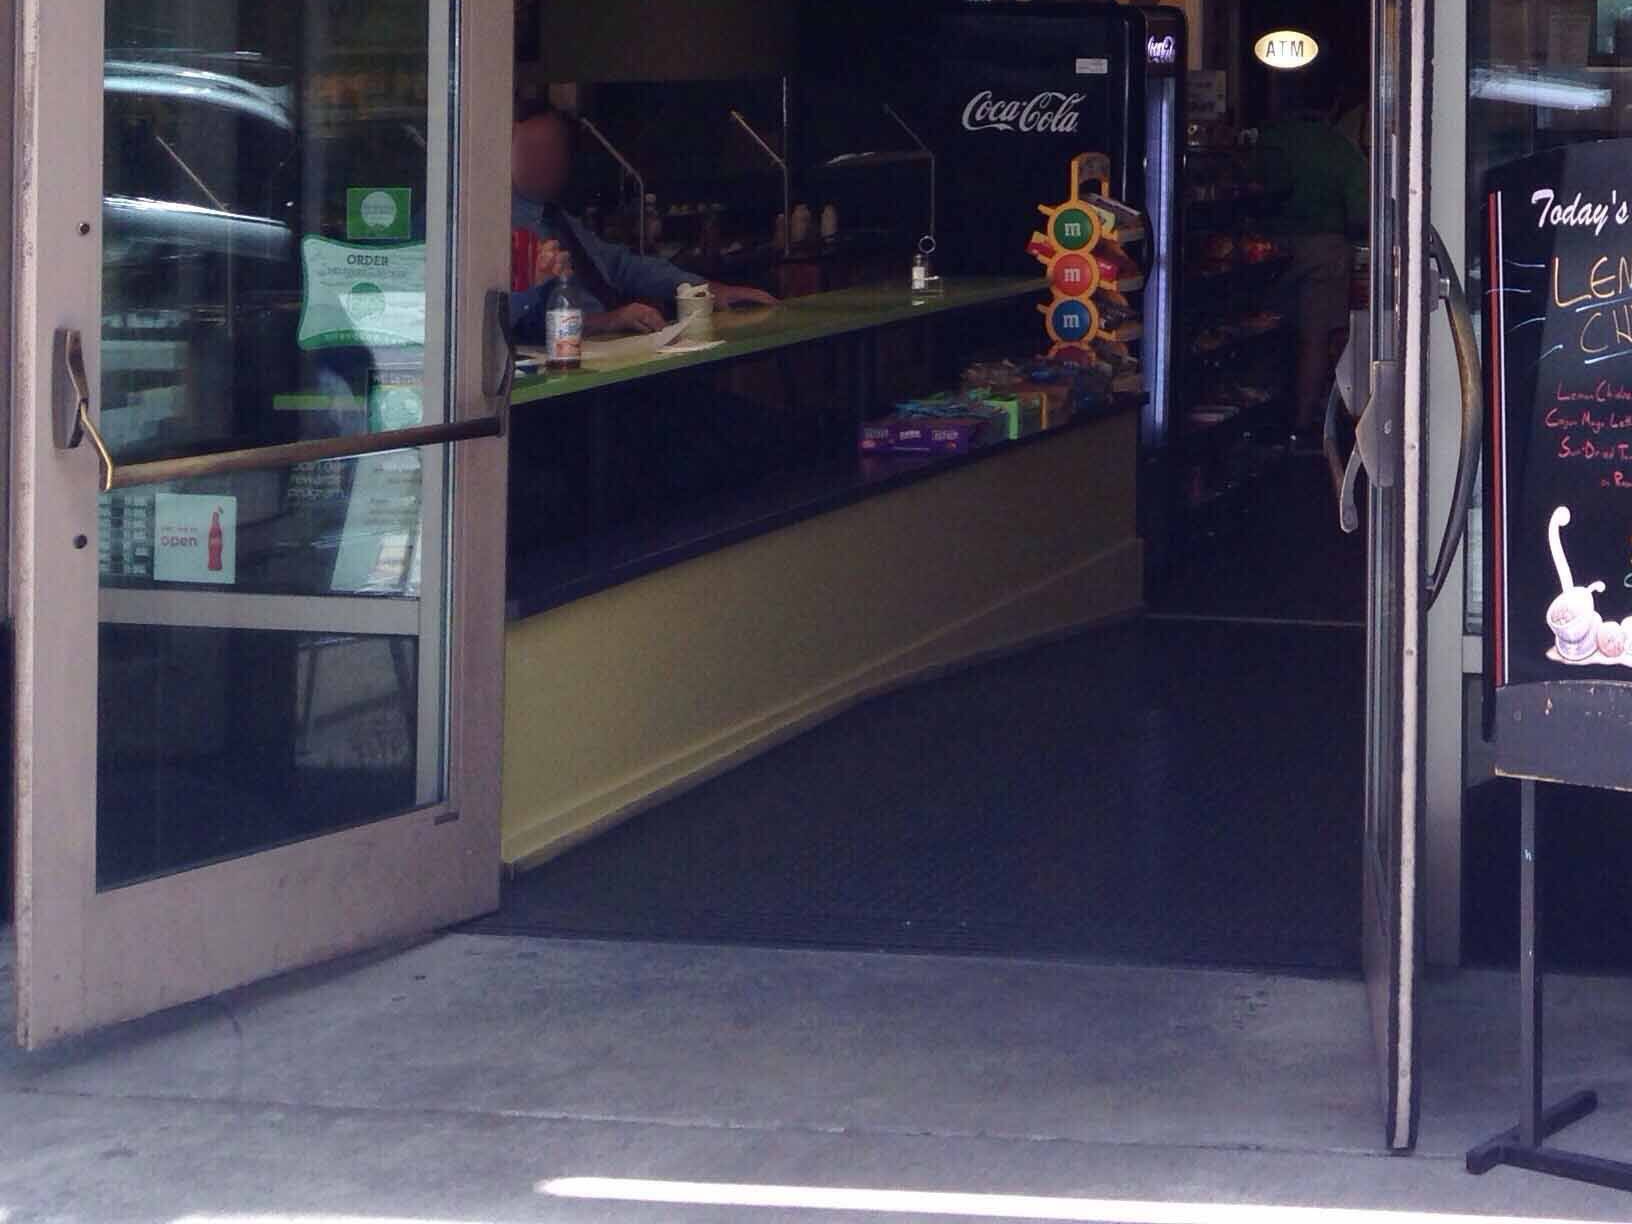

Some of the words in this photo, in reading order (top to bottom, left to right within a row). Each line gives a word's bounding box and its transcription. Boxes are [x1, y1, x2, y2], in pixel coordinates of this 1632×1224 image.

[1265, 40, 1304, 57] ATM
[961, 90, 1087, 133] Coca-Cola
[1531, 188, 1630, 236] Today's
[346, 254, 389, 266] ORDER
